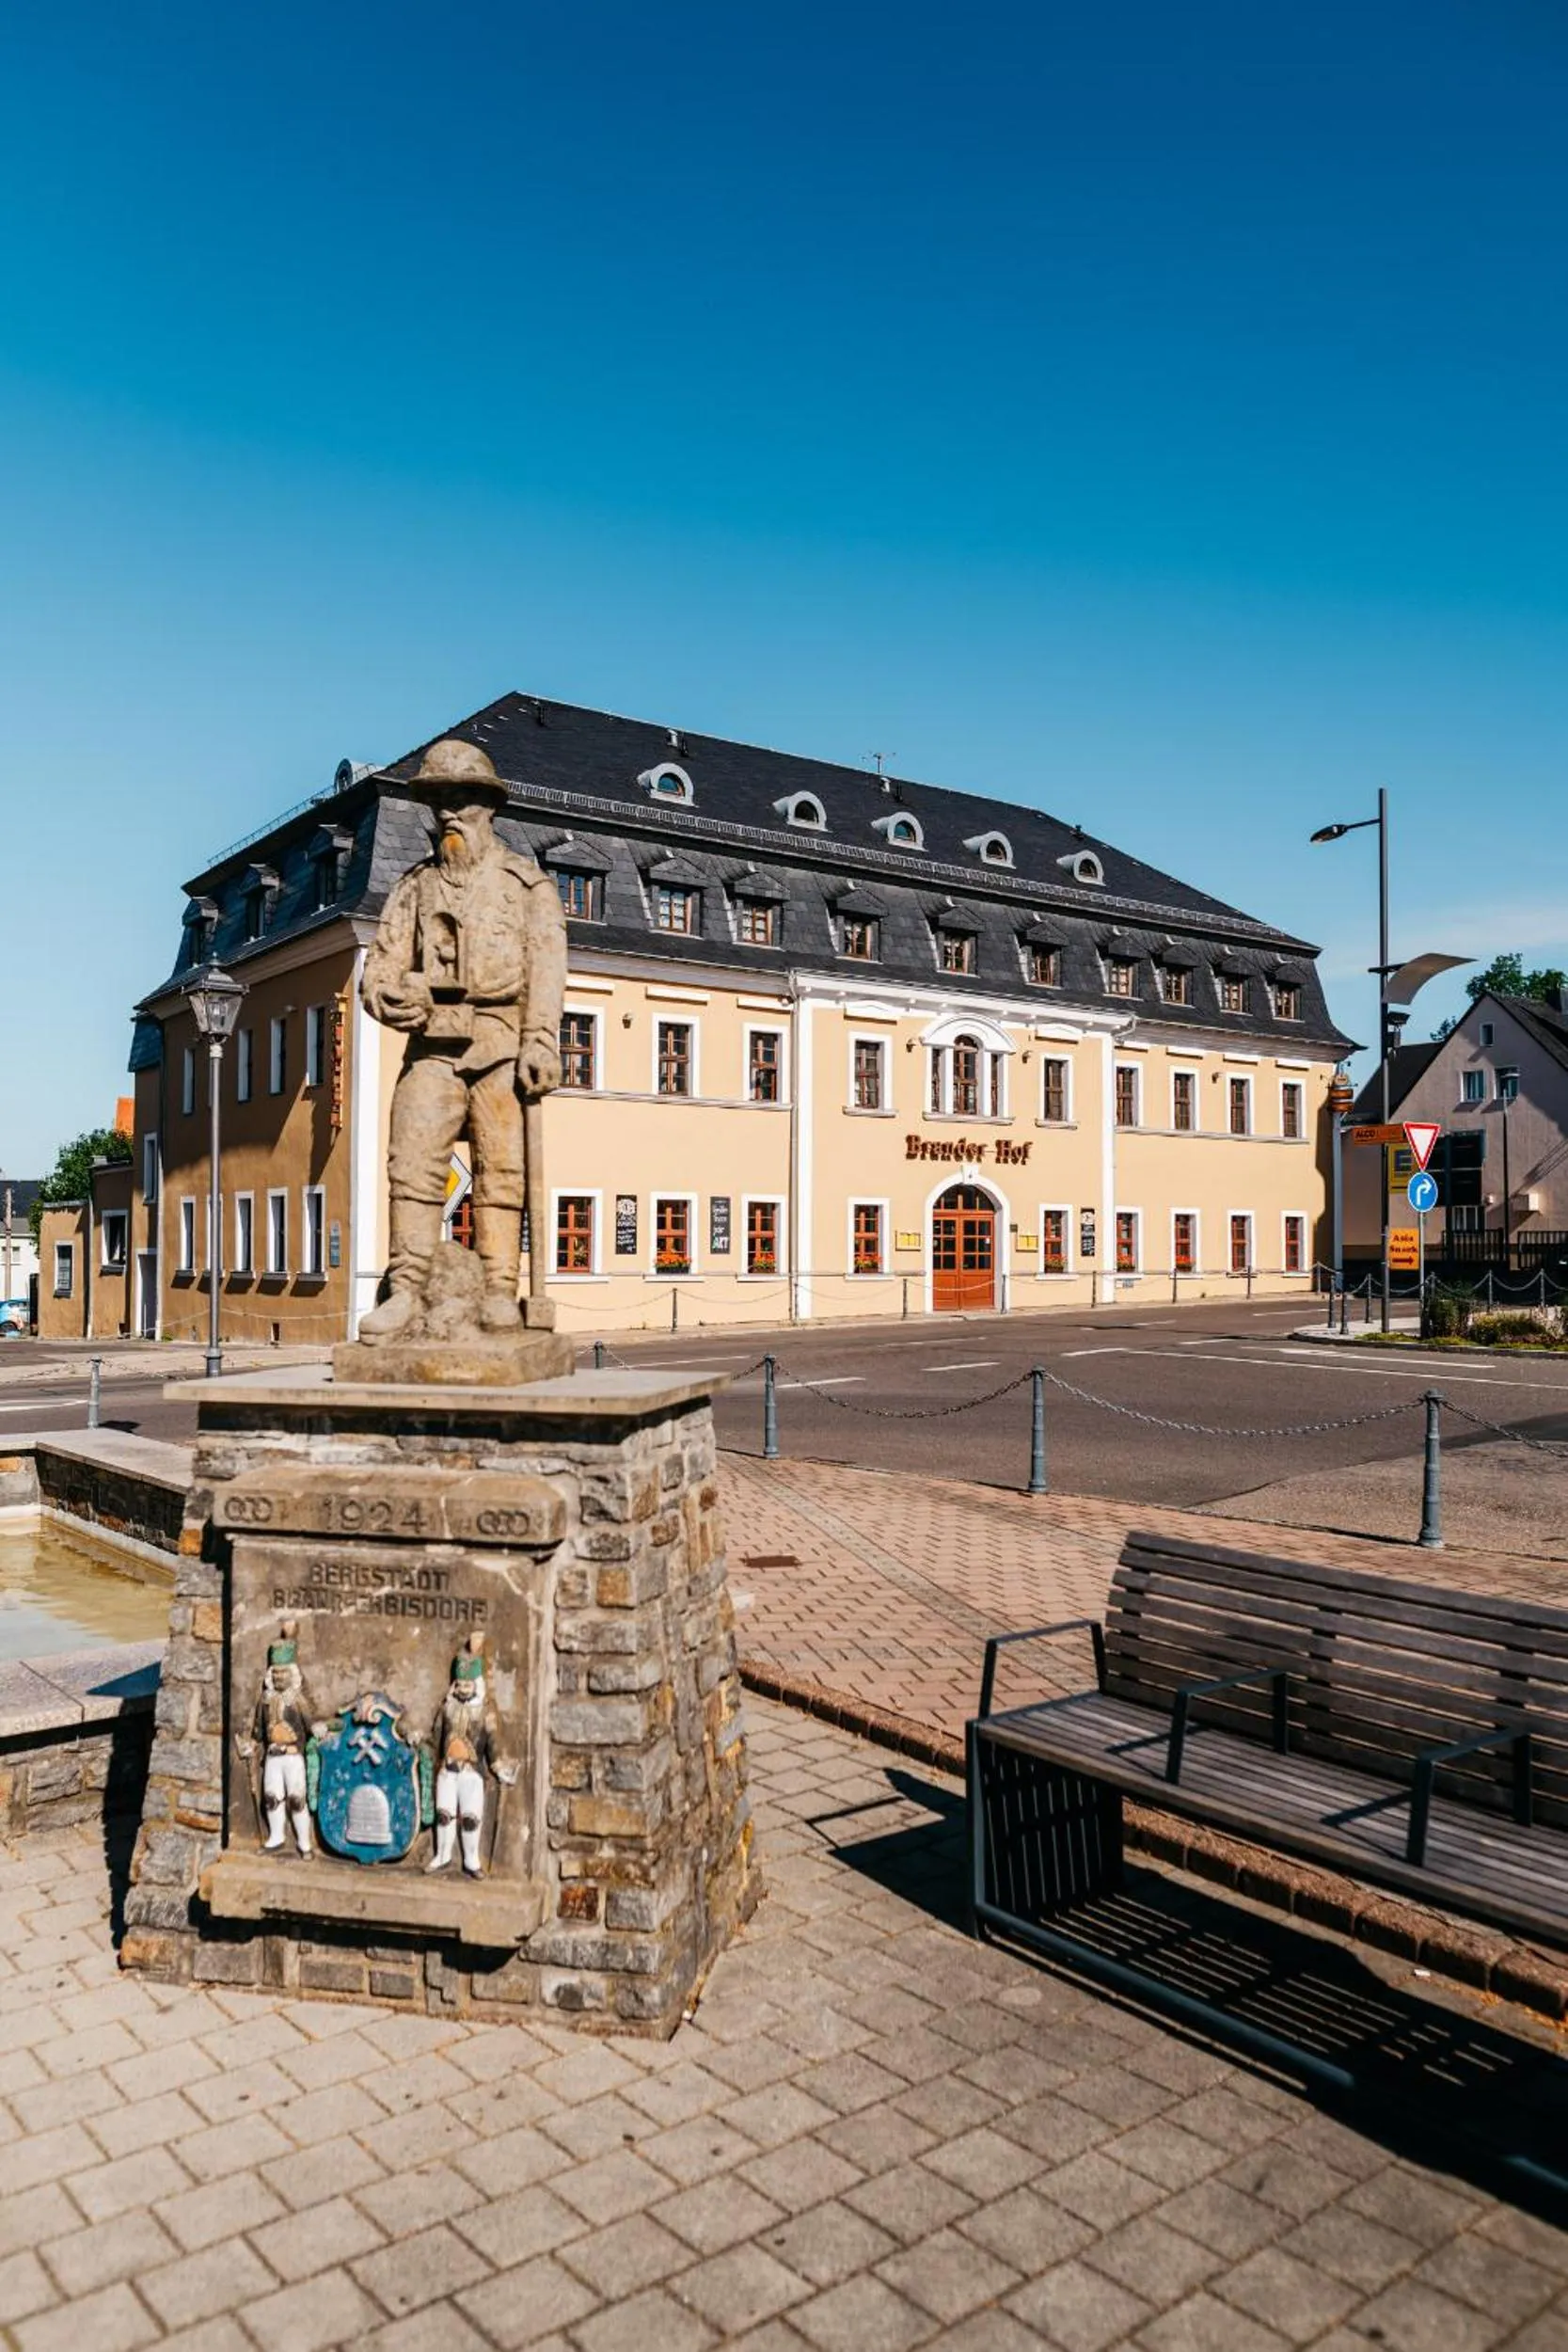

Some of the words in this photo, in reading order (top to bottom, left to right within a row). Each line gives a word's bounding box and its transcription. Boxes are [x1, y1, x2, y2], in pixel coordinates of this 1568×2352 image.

[905, 1135, 987, 1163] Brander
[995, 1139, 1033, 1165] Hof
[1390, 1245, 1418, 1253] Snack
[324, 1499, 428, 1534] 1924
[310, 1562, 450, 1592] BERGSTADT
